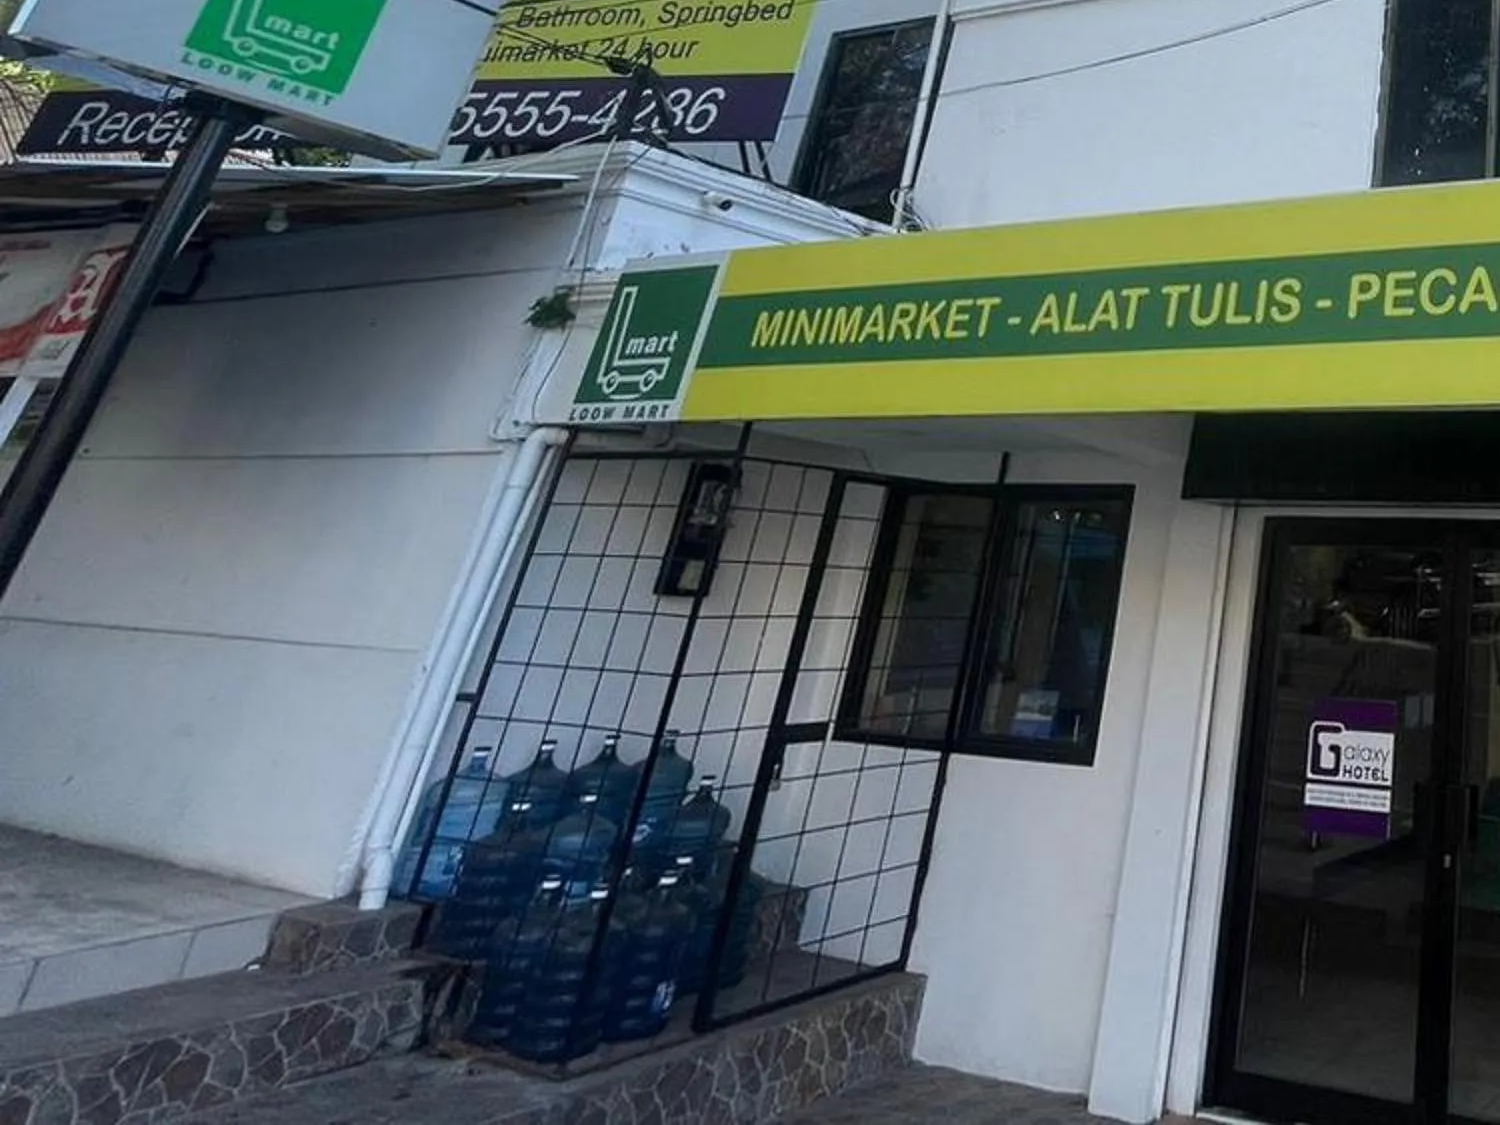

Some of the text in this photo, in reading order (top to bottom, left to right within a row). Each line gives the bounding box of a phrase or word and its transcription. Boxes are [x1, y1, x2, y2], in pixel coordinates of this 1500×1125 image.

[599, 36, 630, 58] 24
[635, 36, 700, 60] hour
[180, 51, 334, 106] LOOW MART
[750, 295, 1001, 349] MINIMARKET
[1029, 286, 1150, 336] ALAT
[1161, 277, 1302, 328] TULIS
[568, 404, 669, 422] LOOW MART
[1342, 765, 1389, 782] HOTEL
